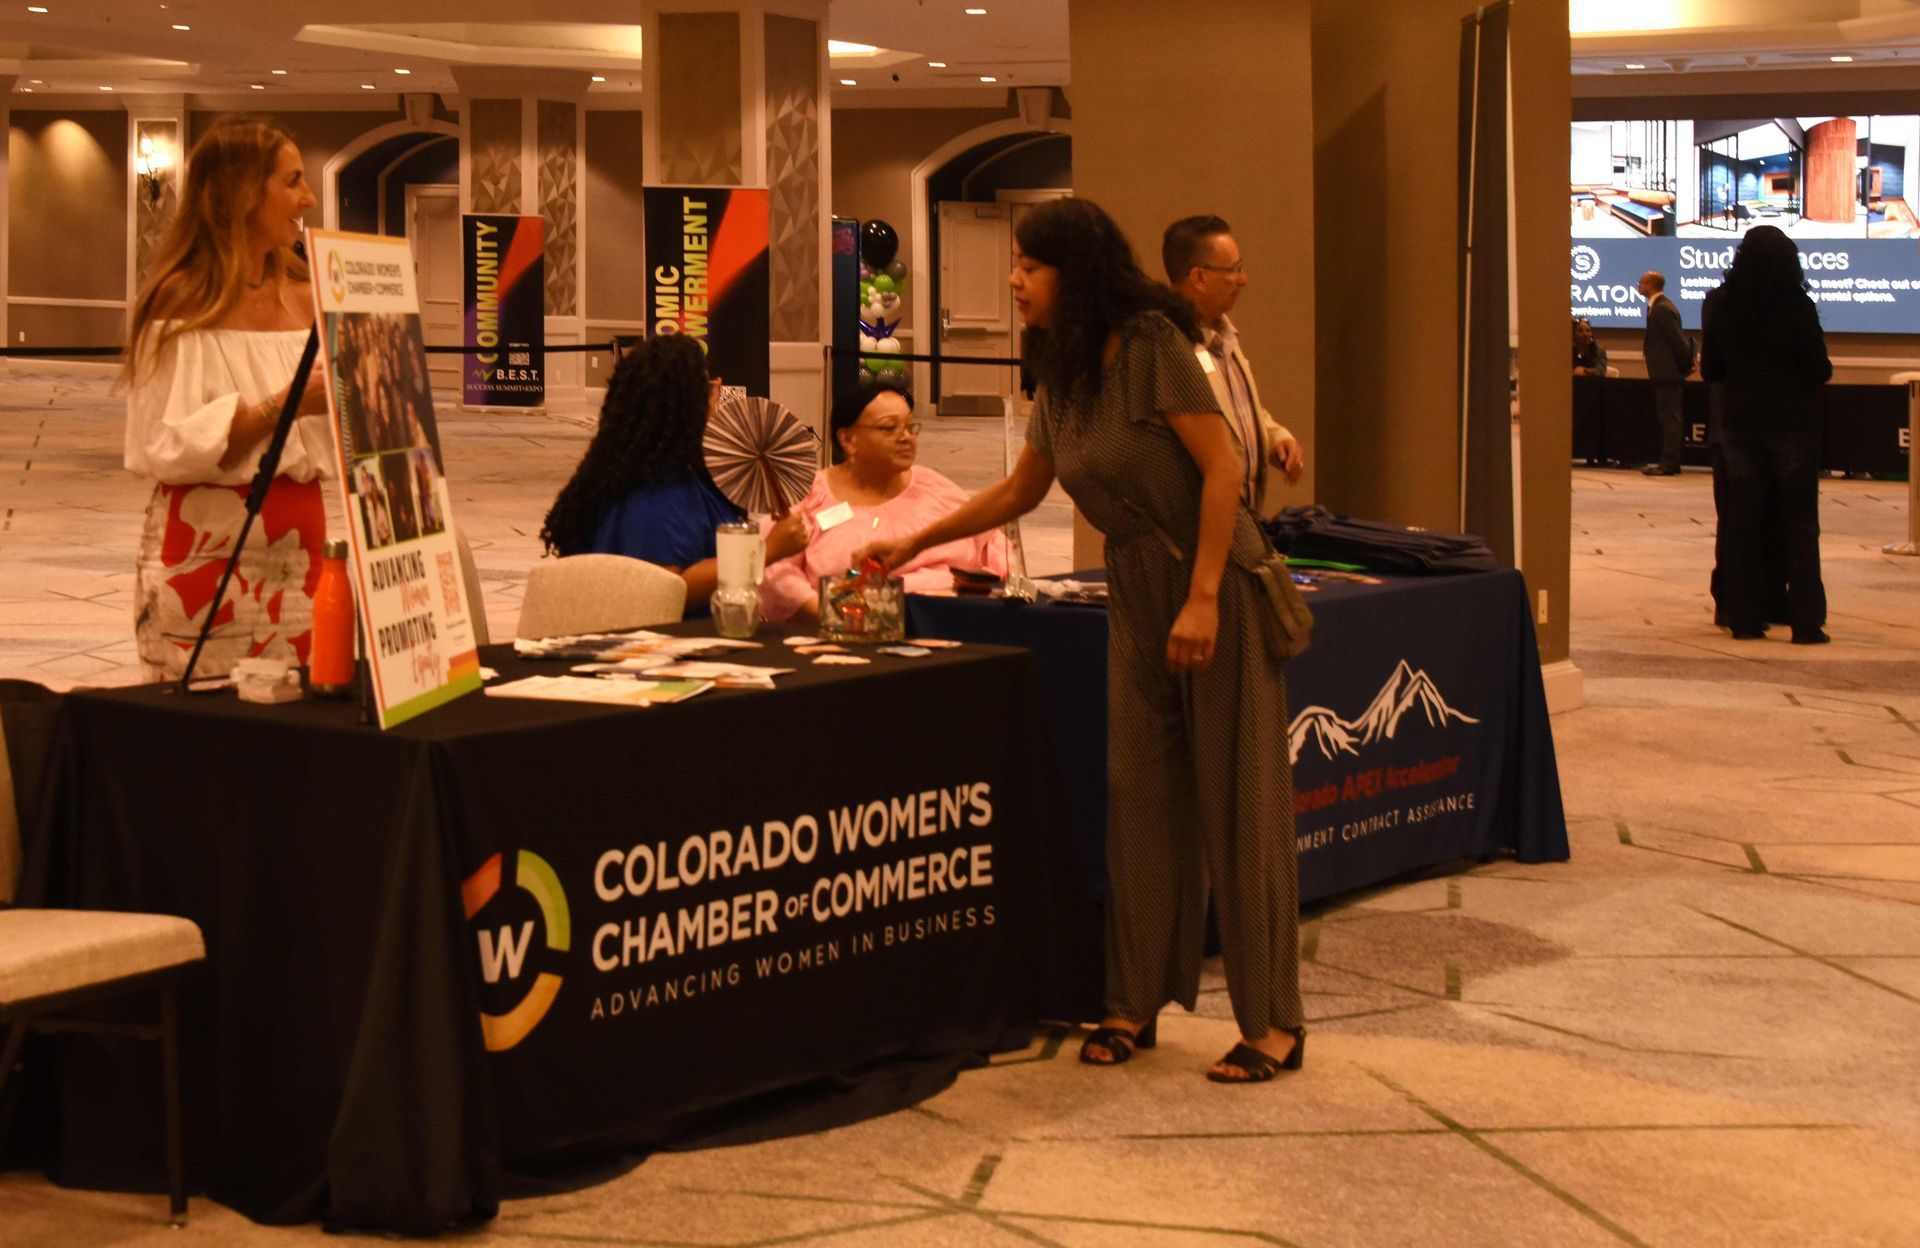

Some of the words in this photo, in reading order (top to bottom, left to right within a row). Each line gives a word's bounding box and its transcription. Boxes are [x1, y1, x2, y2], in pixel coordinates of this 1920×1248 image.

[476, 220, 499, 364] COMMUNITY
[496, 368, 540, 381] B.E.S.T.
[370, 549, 426, 593] ADVANCING
[378, 611, 437, 659] PROMOTING
[594, 814, 818, 902] COLORADO
[829, 781, 993, 855] WOMEN'S
[1342, 810, 1401, 842] CONTRACT
[592, 889, 779, 973] CHAMBER
[784, 893, 809, 919] OF
[812, 844, 993, 923] COMMERCE
[590, 963, 741, 1020] ADVANCING
[756, 941, 840, 979] WOMEN
[852, 932, 874, 956] IN
[884, 904, 996, 946] BUSINESS
